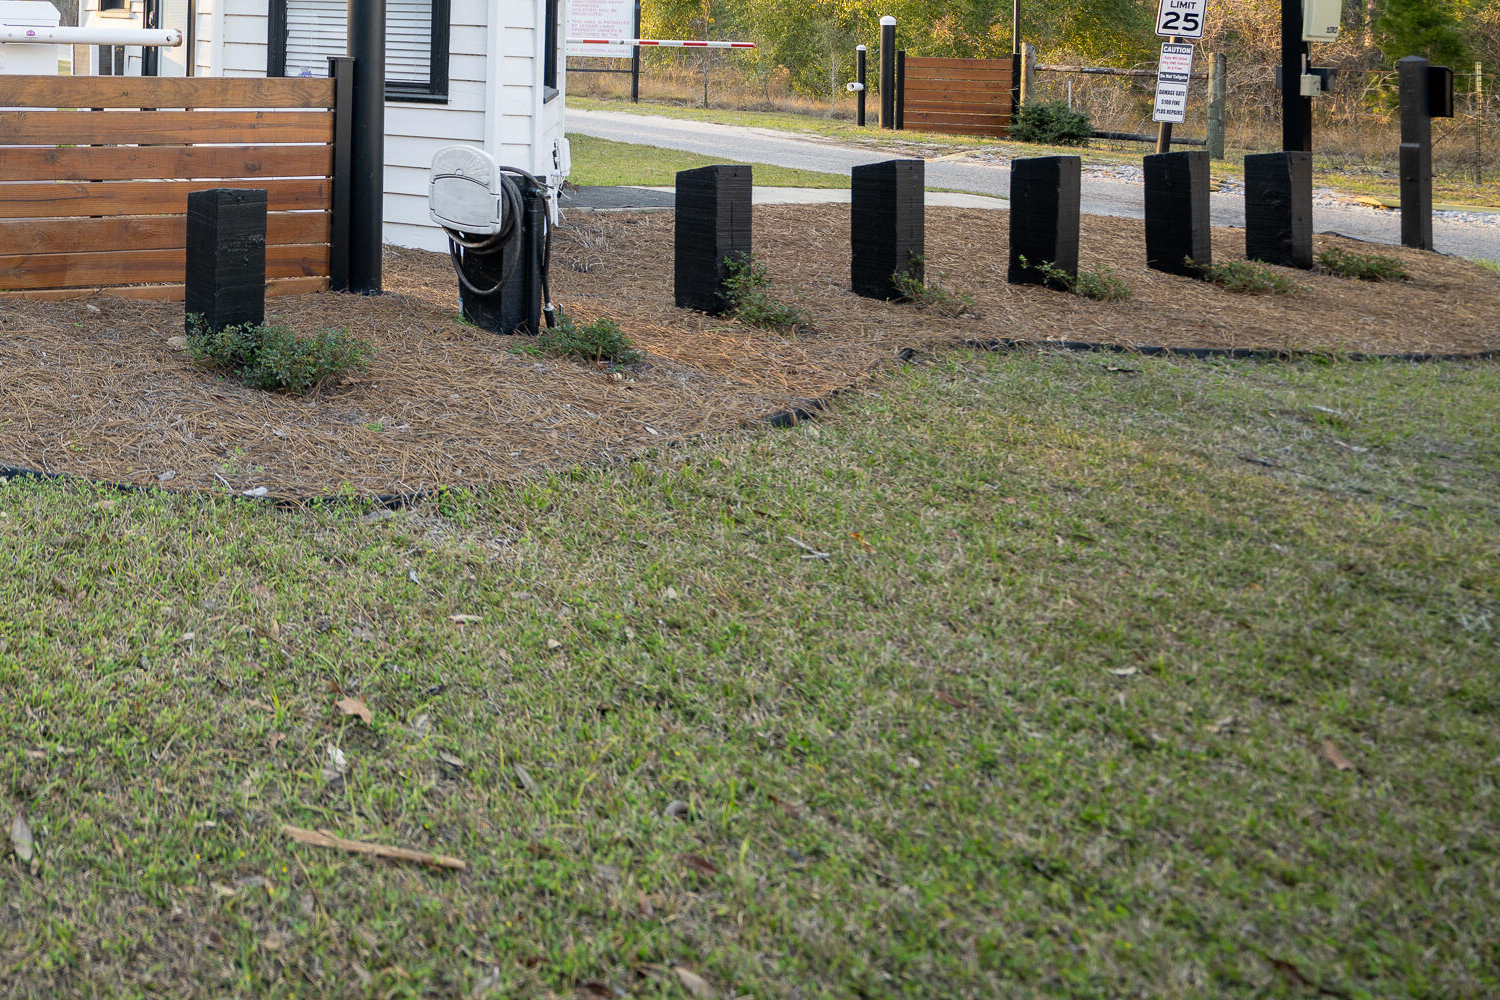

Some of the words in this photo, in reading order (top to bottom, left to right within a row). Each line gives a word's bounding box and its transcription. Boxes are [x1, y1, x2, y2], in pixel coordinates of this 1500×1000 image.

[1170, 0, 1197, 9] LIMIT
[1161, 11, 1199, 31] 25
[1163, 46, 1191, 54] CAUTION
